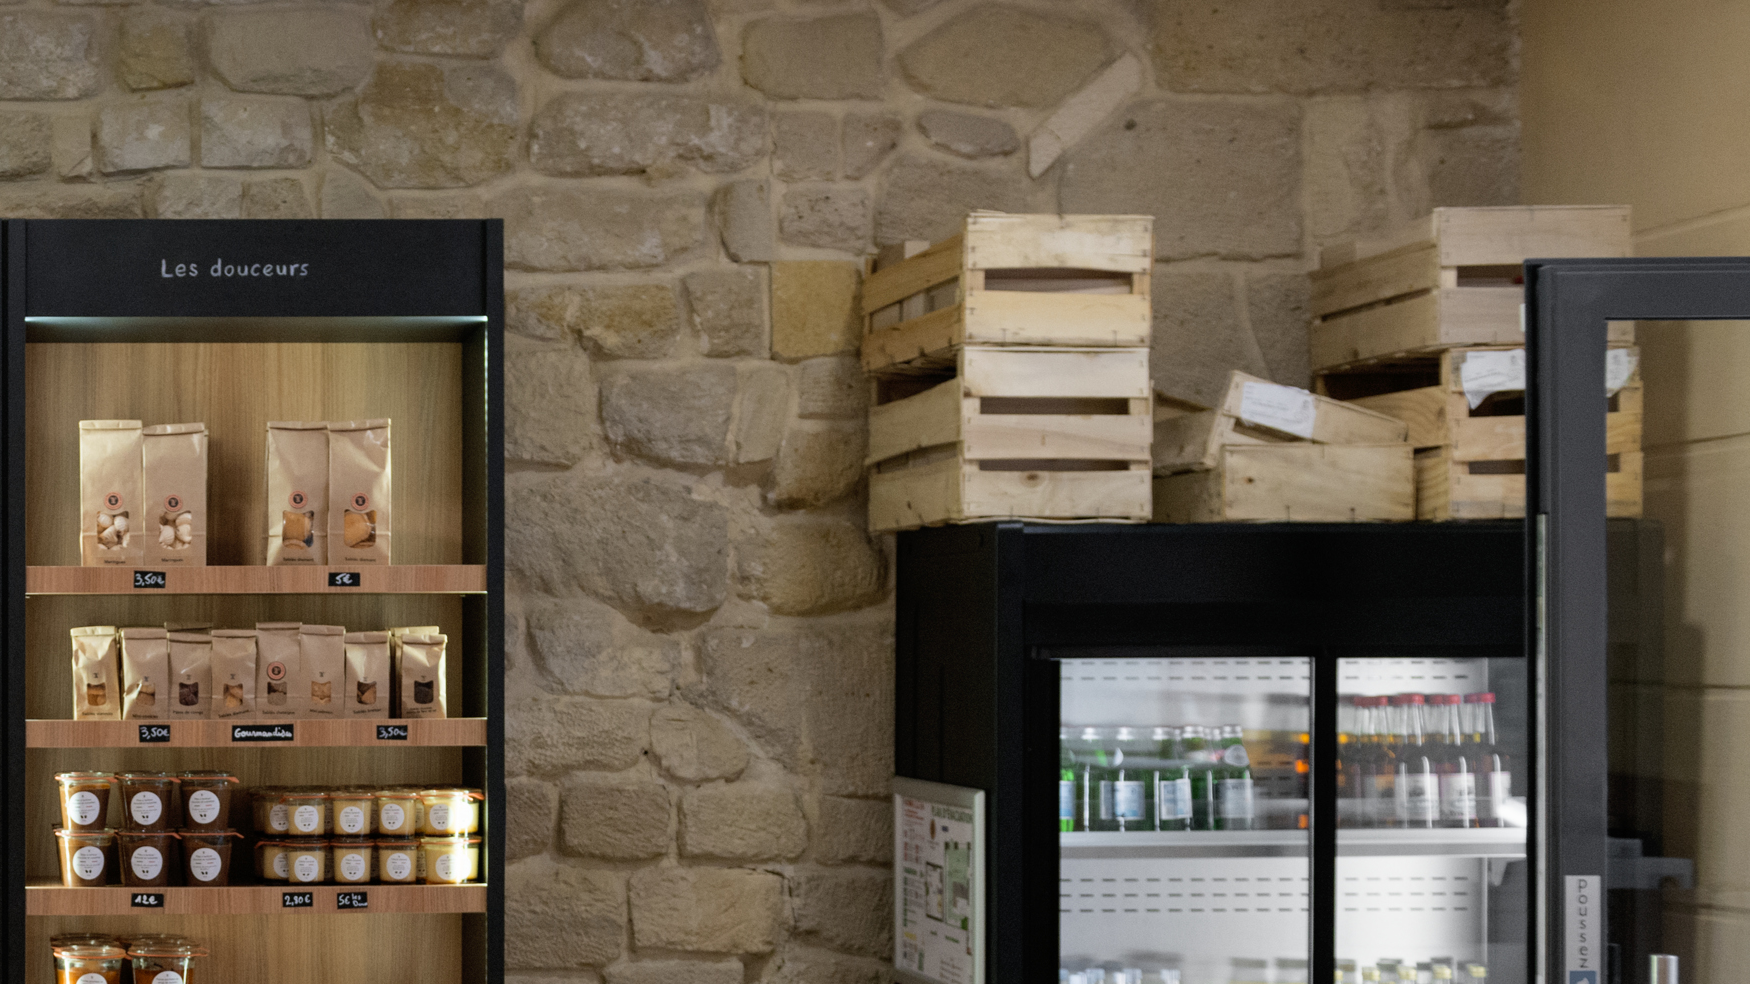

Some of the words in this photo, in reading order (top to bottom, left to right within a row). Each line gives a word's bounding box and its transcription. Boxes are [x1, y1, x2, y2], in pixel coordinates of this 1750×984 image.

[161, 258, 199, 278] Les
[210, 258, 310, 277] douceurs
[135, 573, 165, 586] 3,50€
[335, 573, 353, 585] 5€
[141, 726, 170, 740] 3,50€
[379, 726, 408, 739] 3,50€
[1577, 878, 1589, 969] poussez
